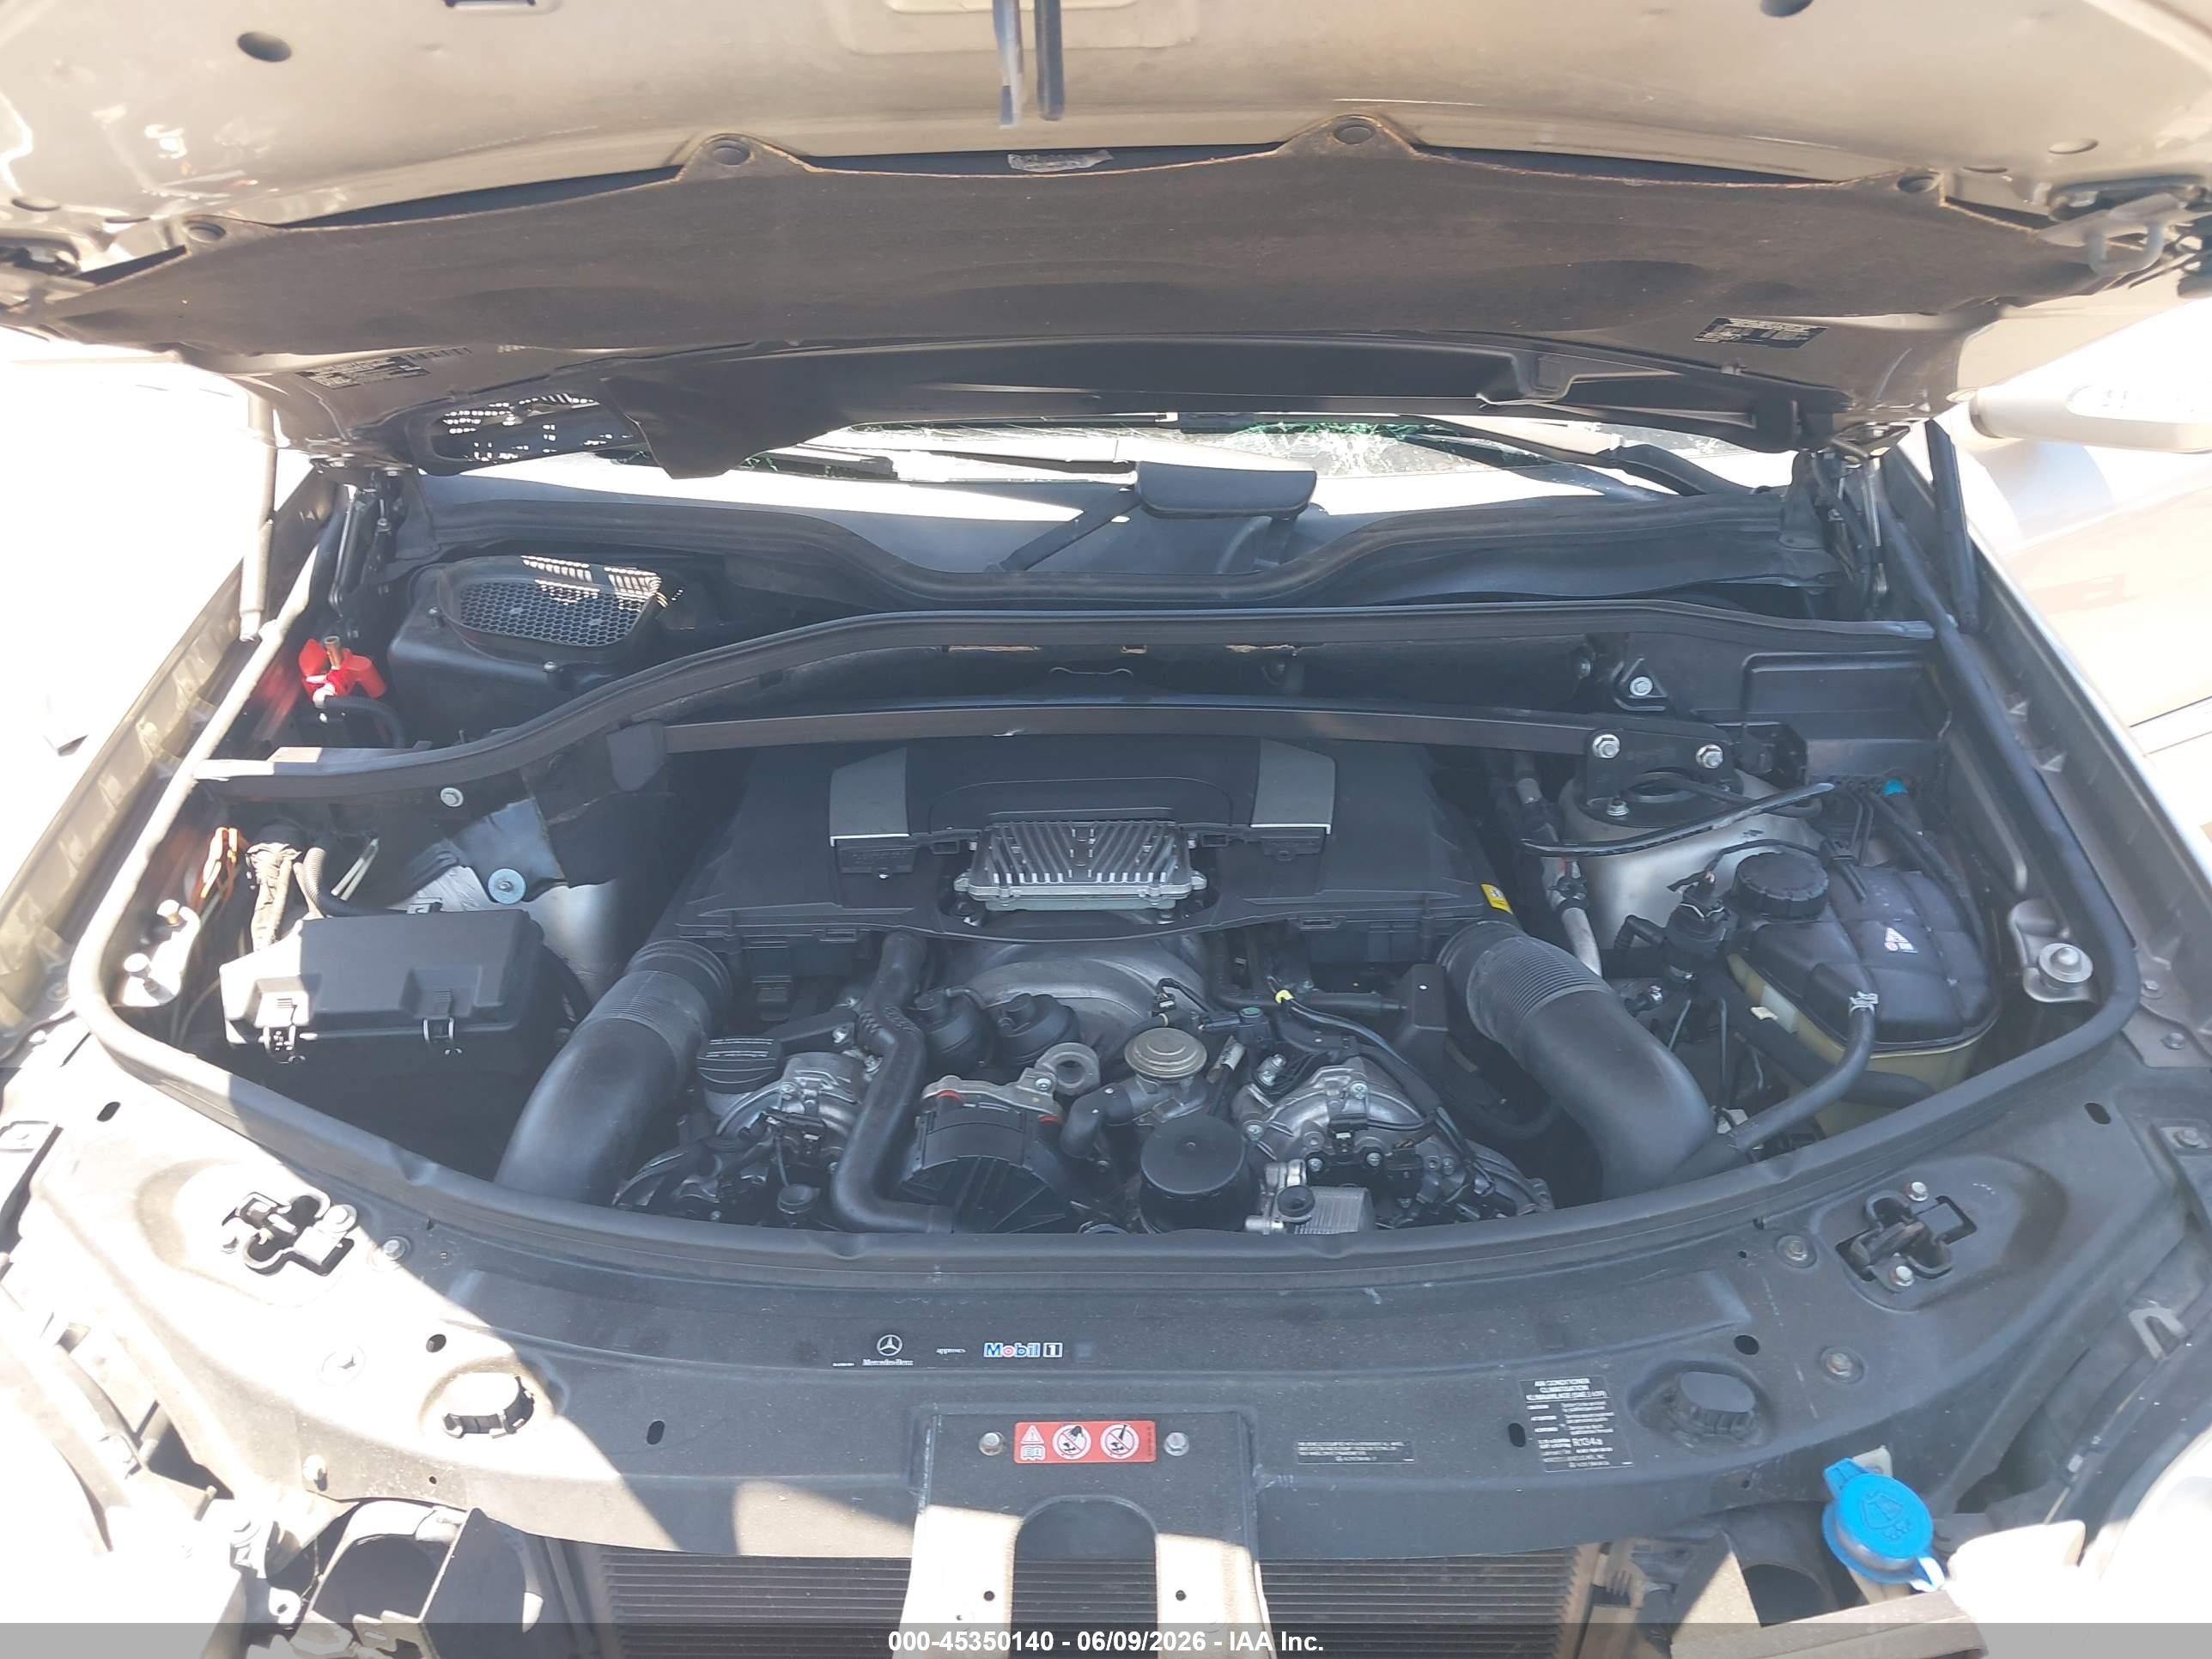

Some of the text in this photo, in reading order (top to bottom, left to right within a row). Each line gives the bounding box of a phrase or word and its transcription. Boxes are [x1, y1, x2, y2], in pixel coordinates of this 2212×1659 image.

[983, 1342, 1062, 1358] Mobil 1
[1572, 1437, 1603, 1446] R134a
